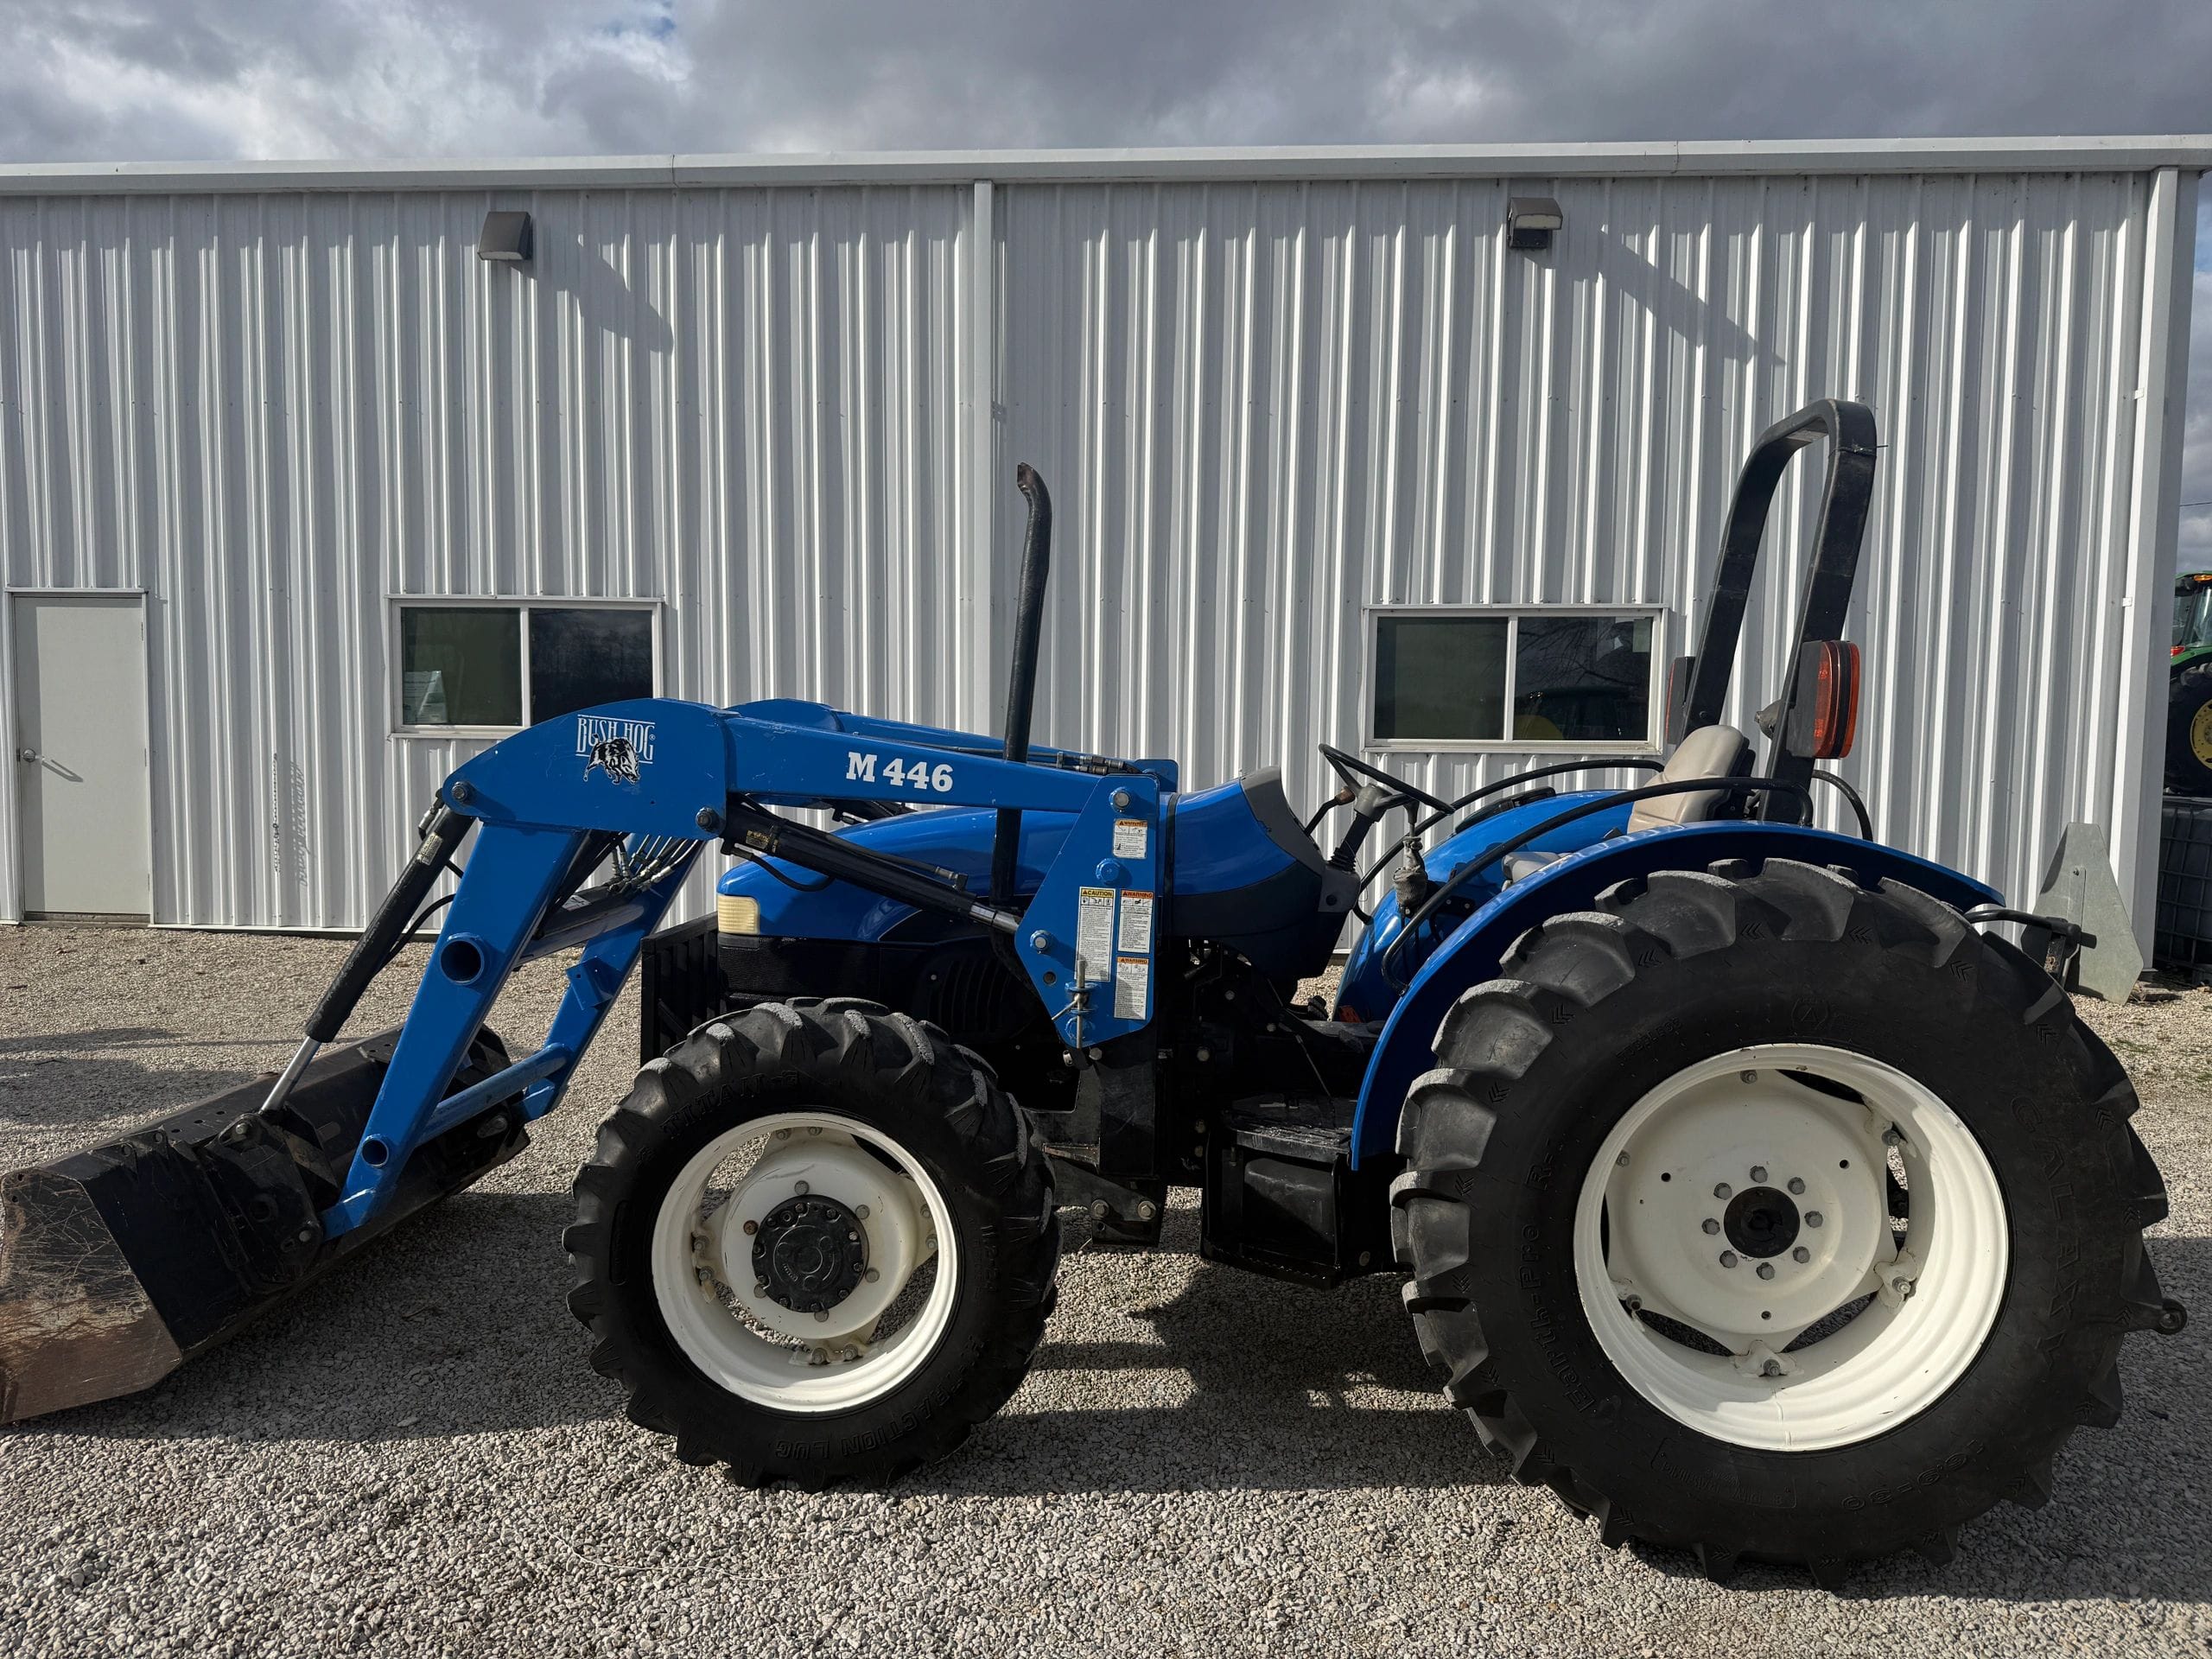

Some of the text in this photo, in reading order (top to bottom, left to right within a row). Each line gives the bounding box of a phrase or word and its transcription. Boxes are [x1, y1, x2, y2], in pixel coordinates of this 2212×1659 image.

[1519, 1223, 1597, 1414] Earth-Pro
[2011, 1095, 2082, 1370] GALAXY
[774, 1438, 831, 1461] LUG
